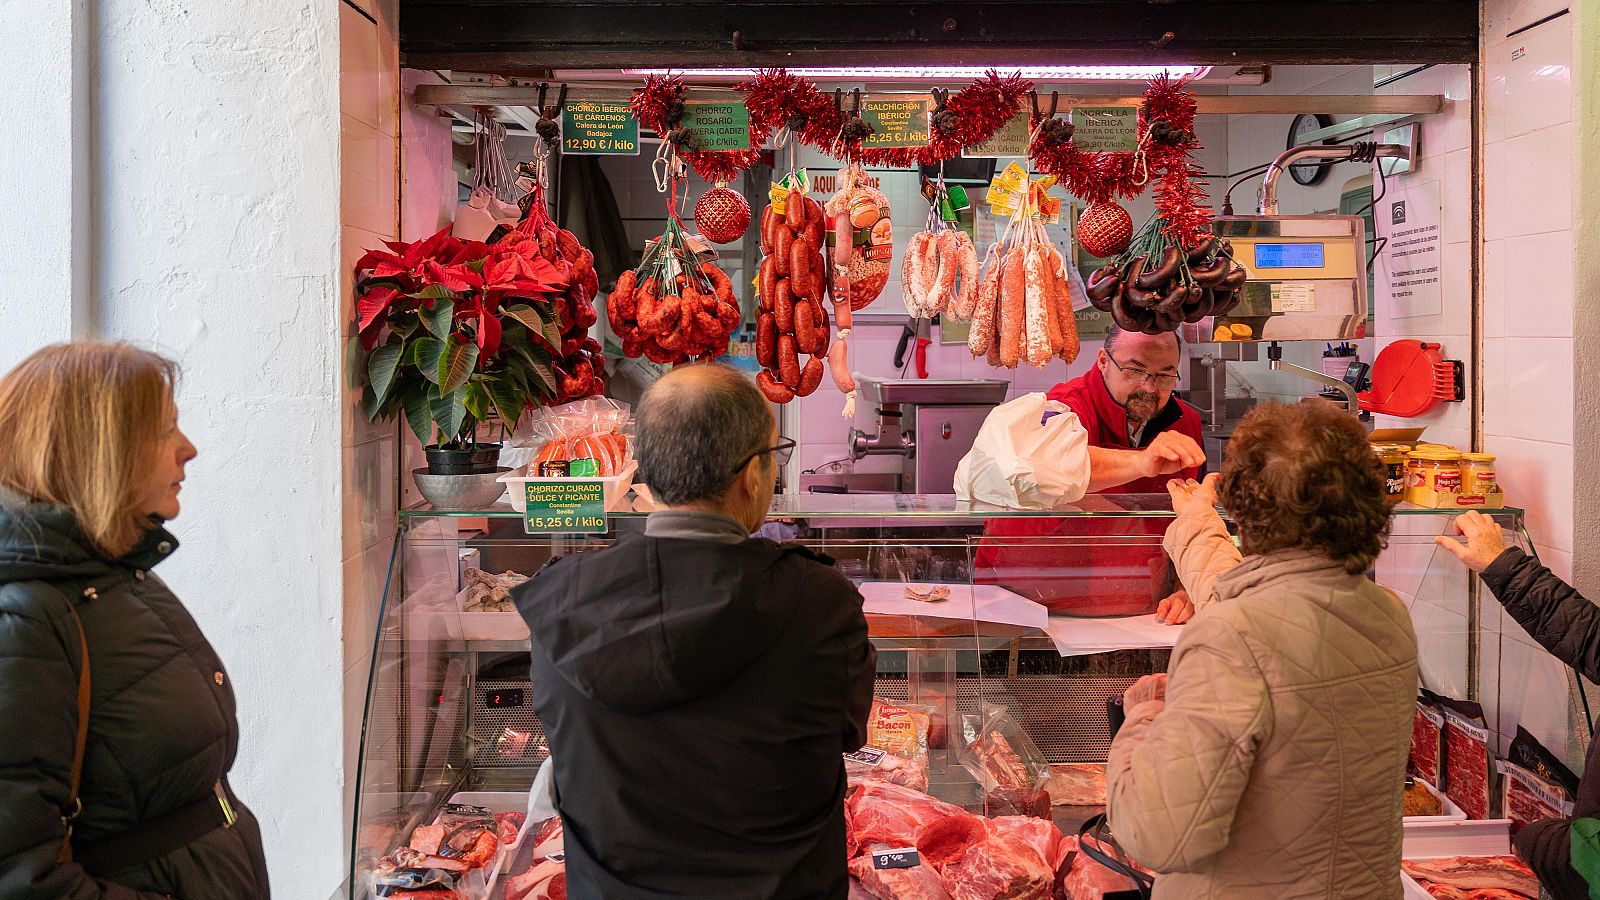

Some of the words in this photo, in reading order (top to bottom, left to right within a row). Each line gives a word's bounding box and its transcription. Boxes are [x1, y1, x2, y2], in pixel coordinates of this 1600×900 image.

[585, 113, 626, 121] CÁRDENOS
[587, 130, 613, 138] Badajoz
[895, 133, 901, 141] €
[910, 132, 928, 141] kilo
[566, 139, 596, 150] 12,90
[599, 139, 606, 149] €
[615, 140, 634, 150] kilo
[529, 518, 562, 528] 15,25
[565, 517, 573, 526] €
[575, 517, 579, 526] /
[582, 517, 603, 526] kilo
[877, 720, 911, 729] Bacon
